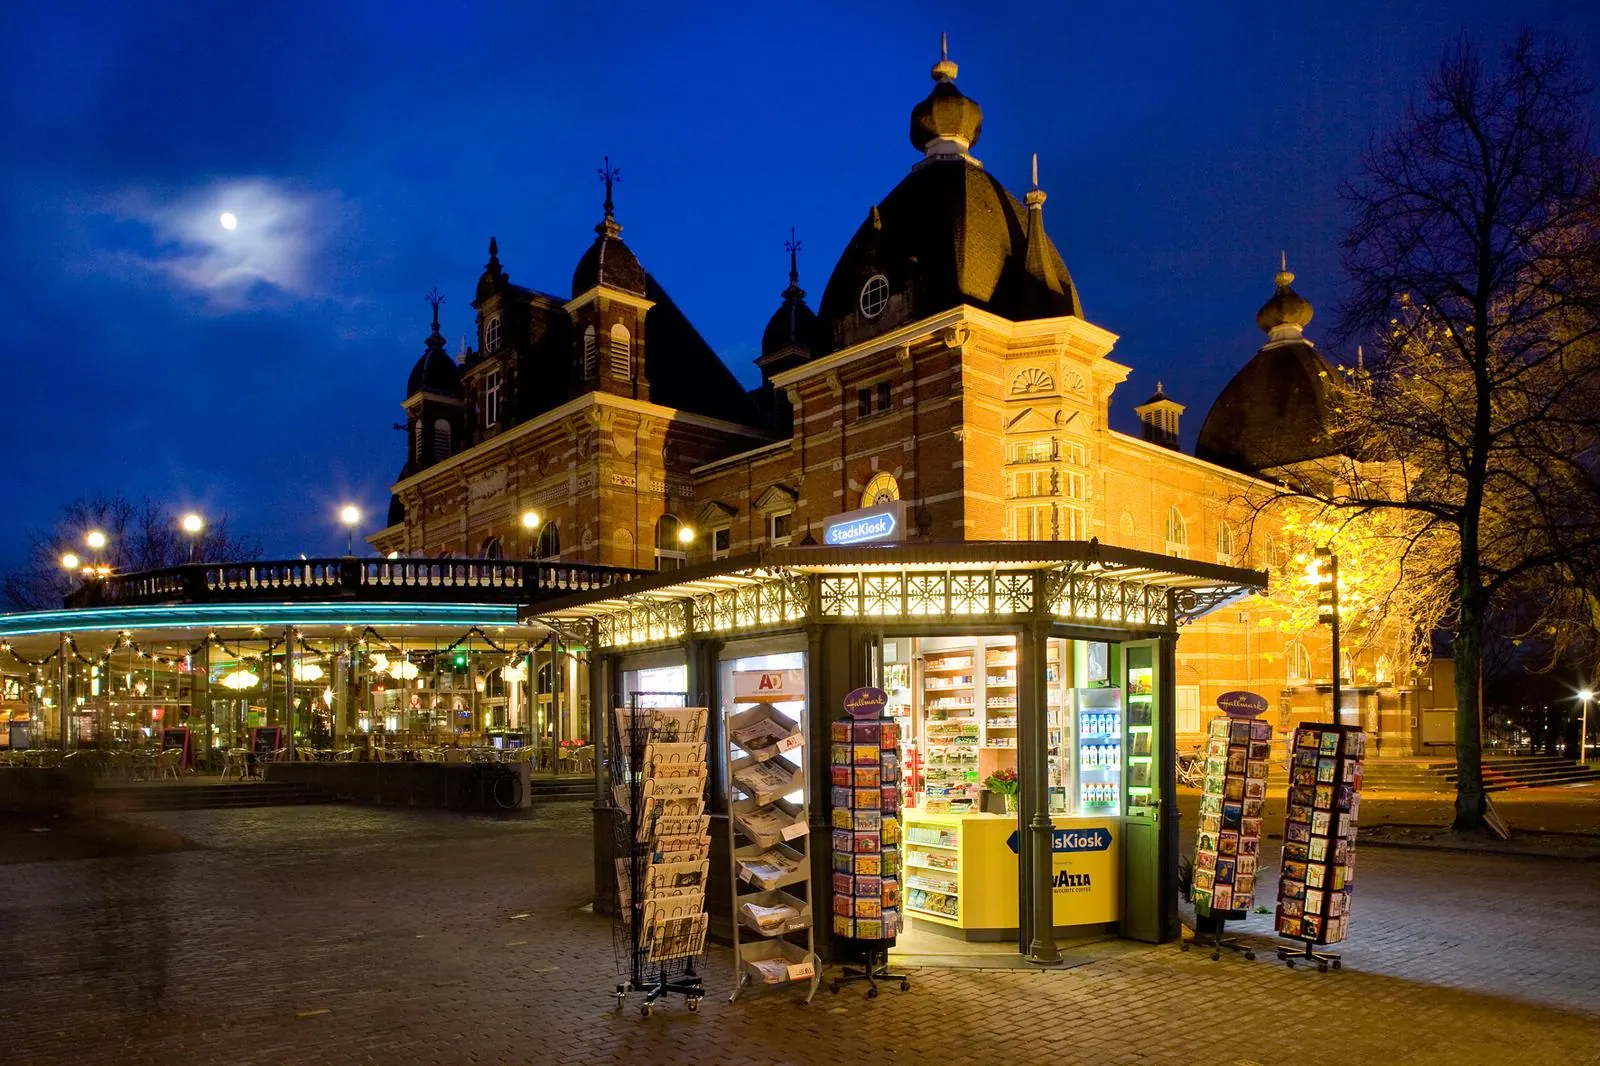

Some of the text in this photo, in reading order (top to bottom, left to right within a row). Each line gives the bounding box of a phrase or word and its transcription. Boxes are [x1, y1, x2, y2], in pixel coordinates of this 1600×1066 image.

[832, 519, 886, 541] StadsKiosk
[847, 694, 886, 712] Hallmark
[1219, 697, 1266, 711] Hallmark
